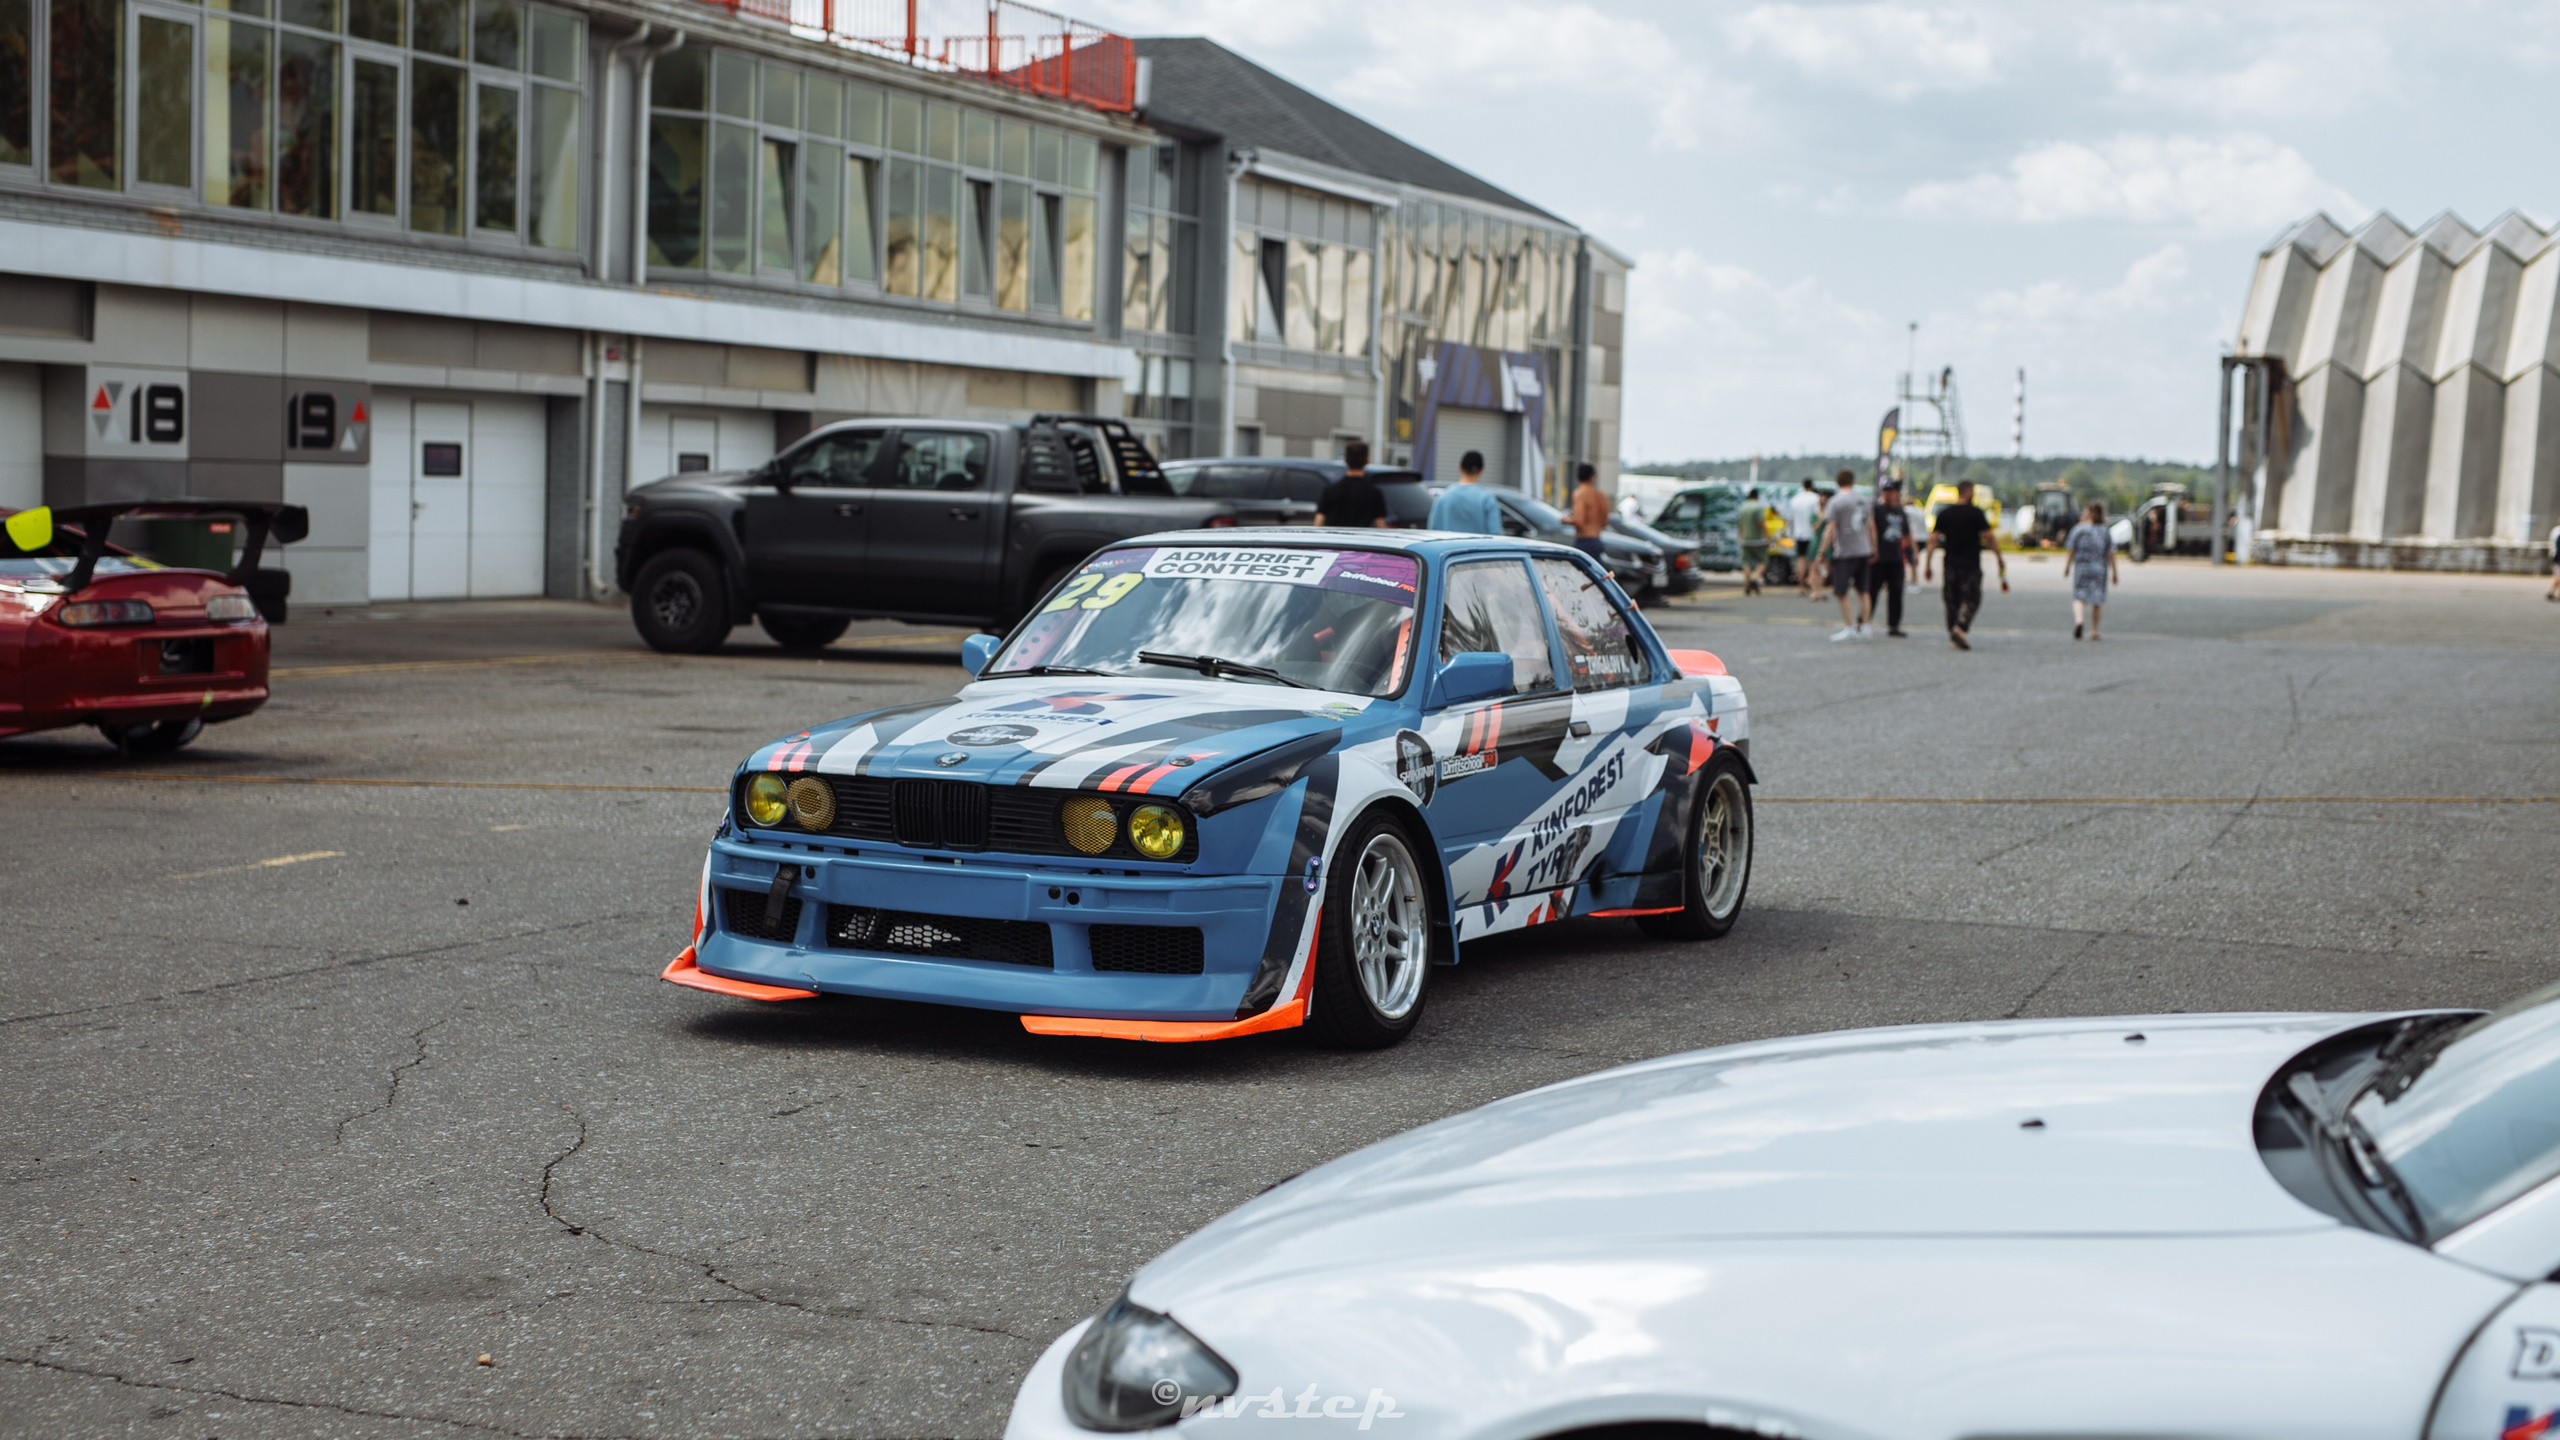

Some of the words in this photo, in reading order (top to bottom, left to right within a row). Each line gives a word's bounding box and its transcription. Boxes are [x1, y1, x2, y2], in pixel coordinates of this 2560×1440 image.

[130, 383, 184, 443] 18
[287, 392, 335, 448] 19
[1154, 563, 1314, 579] CONTEST
[1162, 552, 1231, 562] ADM
[1233, 553, 1323, 566] DRIFT
[1041, 572, 1144, 613] 29
[1531, 747, 1625, 858] KINFOREST
